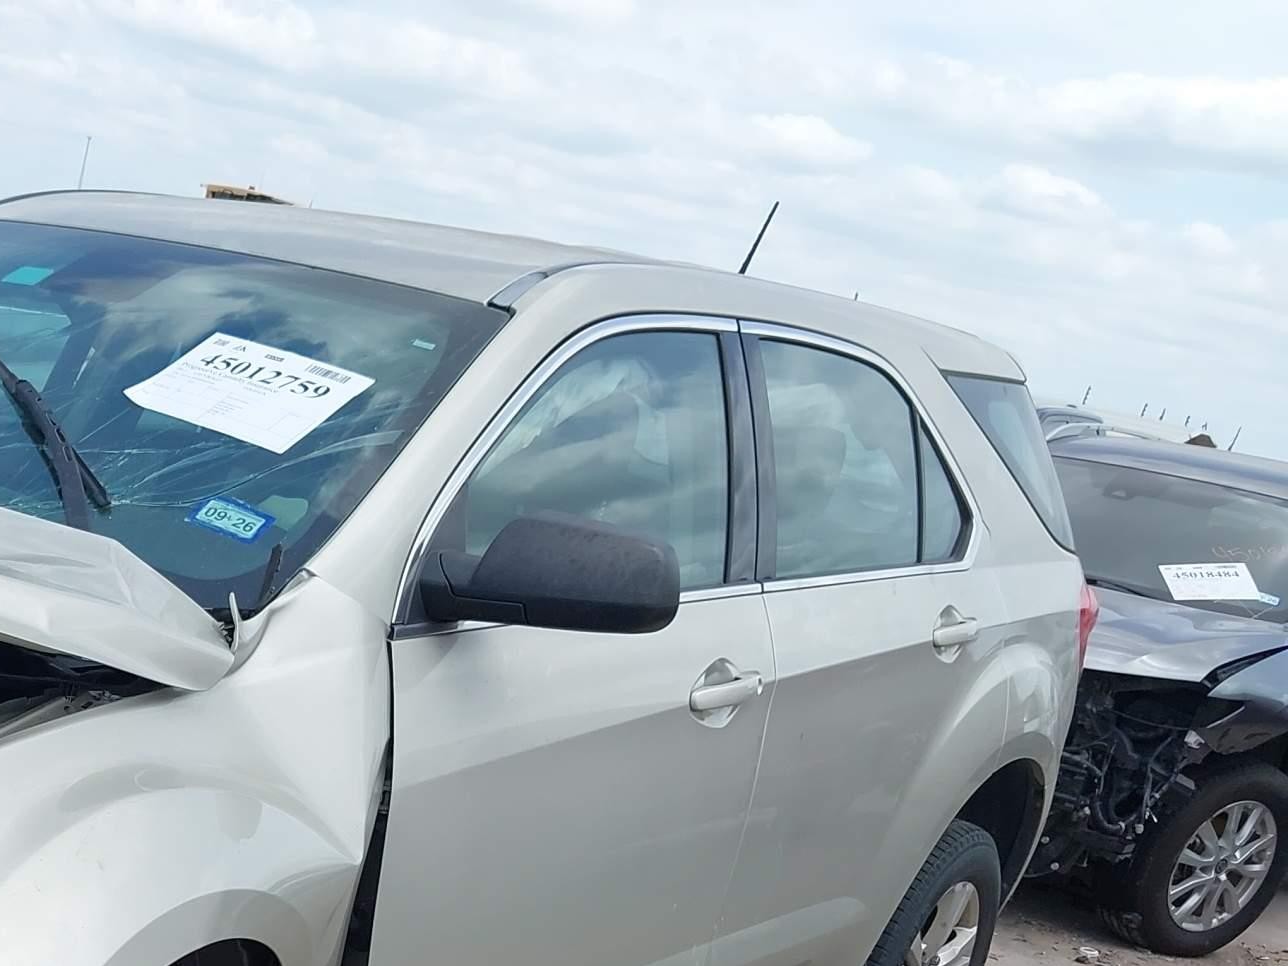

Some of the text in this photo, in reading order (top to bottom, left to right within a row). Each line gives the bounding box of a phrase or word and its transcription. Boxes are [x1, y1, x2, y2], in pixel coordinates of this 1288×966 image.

[200, 353, 331, 399] 45012759
[204, 507, 257, 533] 09 26
